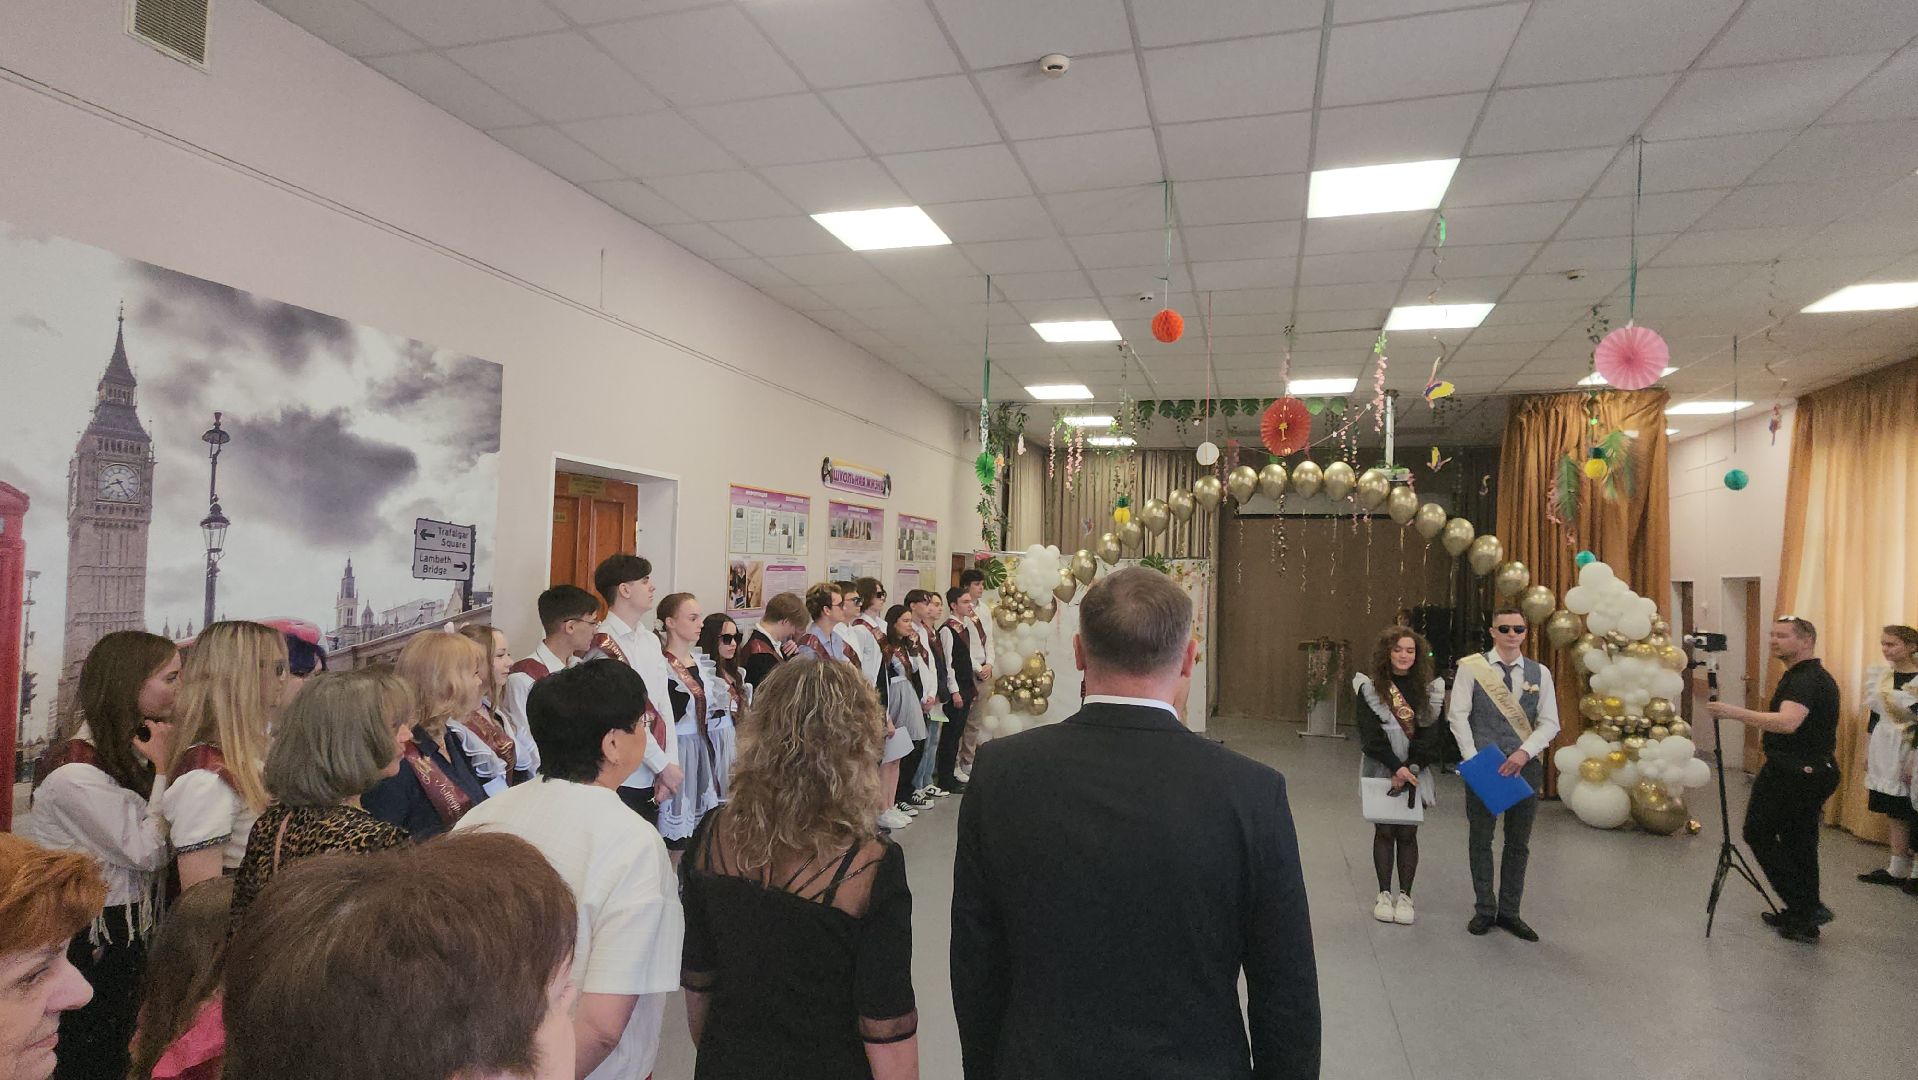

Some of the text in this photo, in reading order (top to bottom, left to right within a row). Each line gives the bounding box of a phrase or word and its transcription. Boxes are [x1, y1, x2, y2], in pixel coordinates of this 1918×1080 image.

[438, 527, 469, 539] Trafalgar
[441, 539, 467, 549] Square
[419, 553, 452, 564] Lambeth
[422, 564, 448, 576] Bridge
